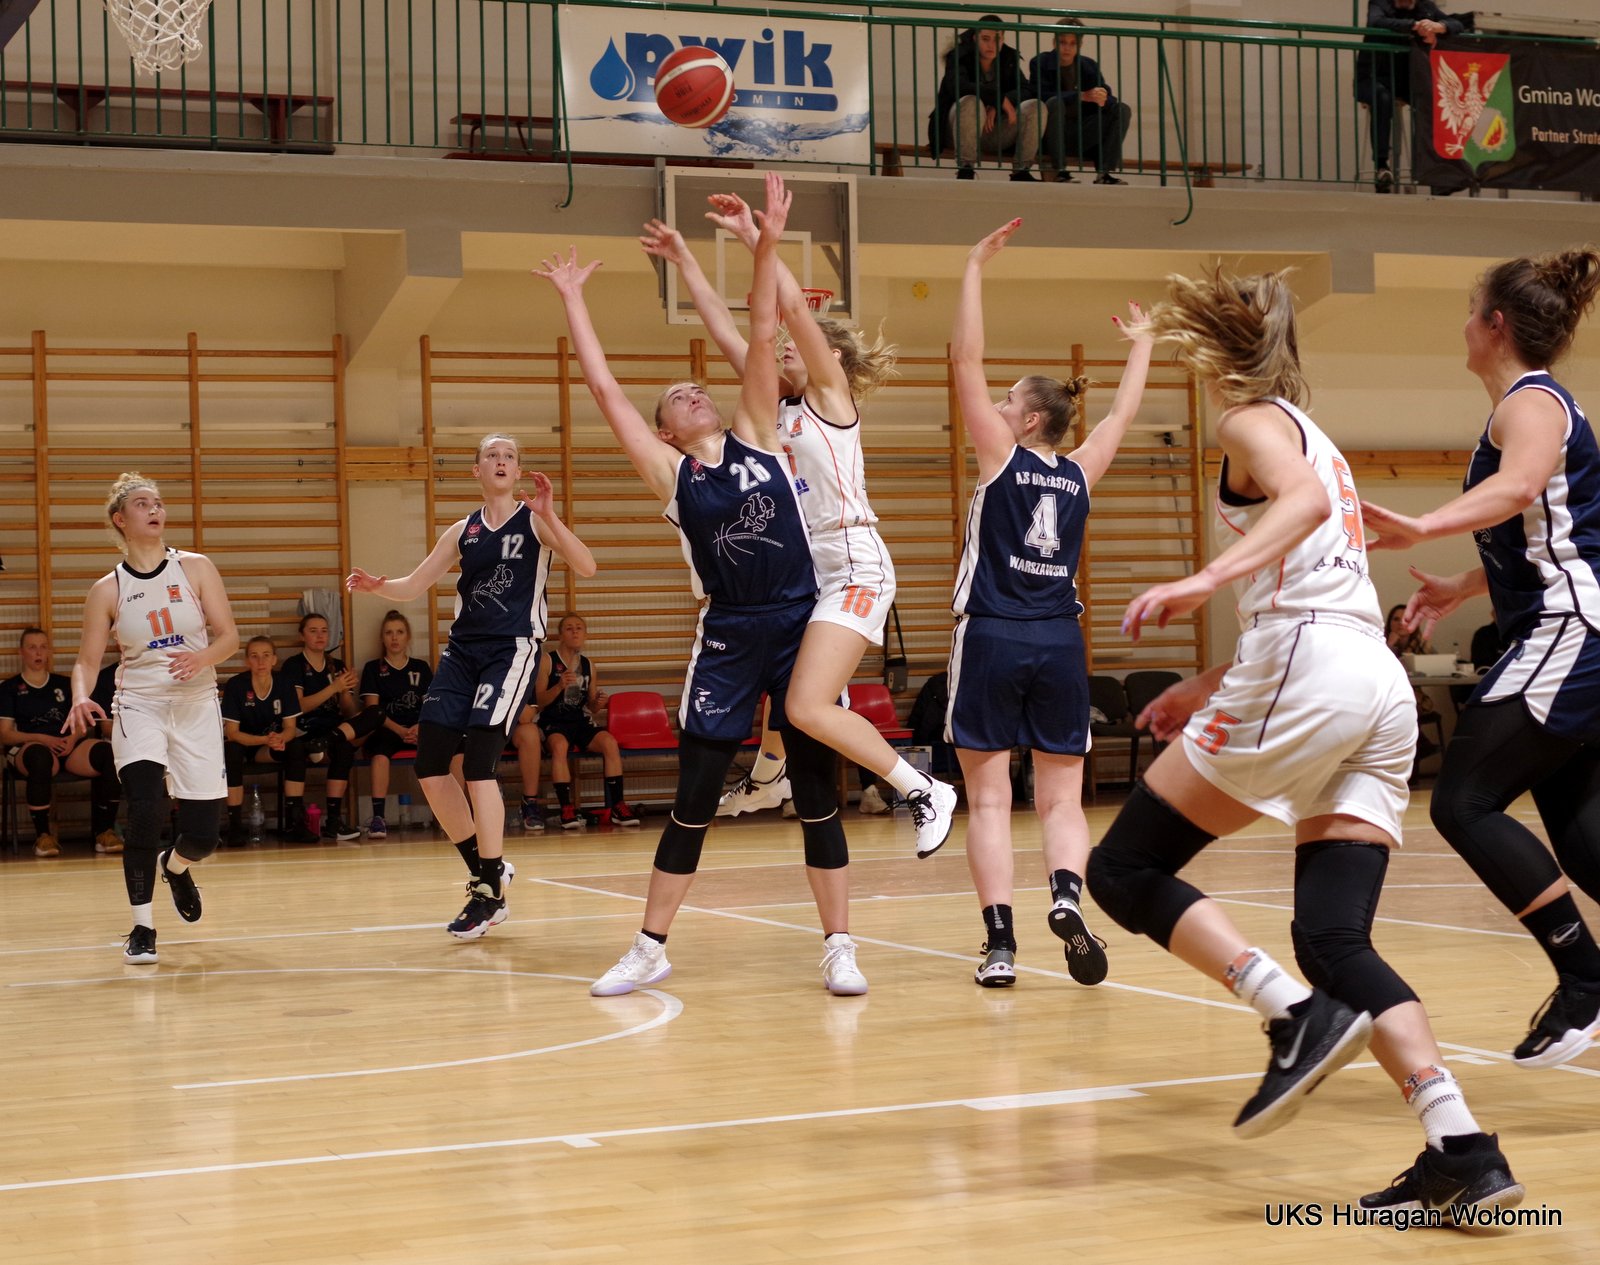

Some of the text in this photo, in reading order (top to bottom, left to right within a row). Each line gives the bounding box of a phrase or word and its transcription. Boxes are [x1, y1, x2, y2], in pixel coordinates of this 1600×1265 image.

[1518, 84, 1573, 106] Gmina
[1531, 126, 1569, 144] Partner
[729, 455, 772, 493] 26
[1024, 493, 1060, 559] 4
[501, 533, 525, 560] 12
[1009, 554, 1068, 577] WARSZAWSKI
[840, 585, 878, 619] 16
[145, 606, 174, 638] 11
[407, 670, 421, 687] 17
[53, 687, 65, 703] 3
[273, 698, 283, 715] 9
[472, 683, 495, 710] 12
[1195, 708, 1242, 756] 5
